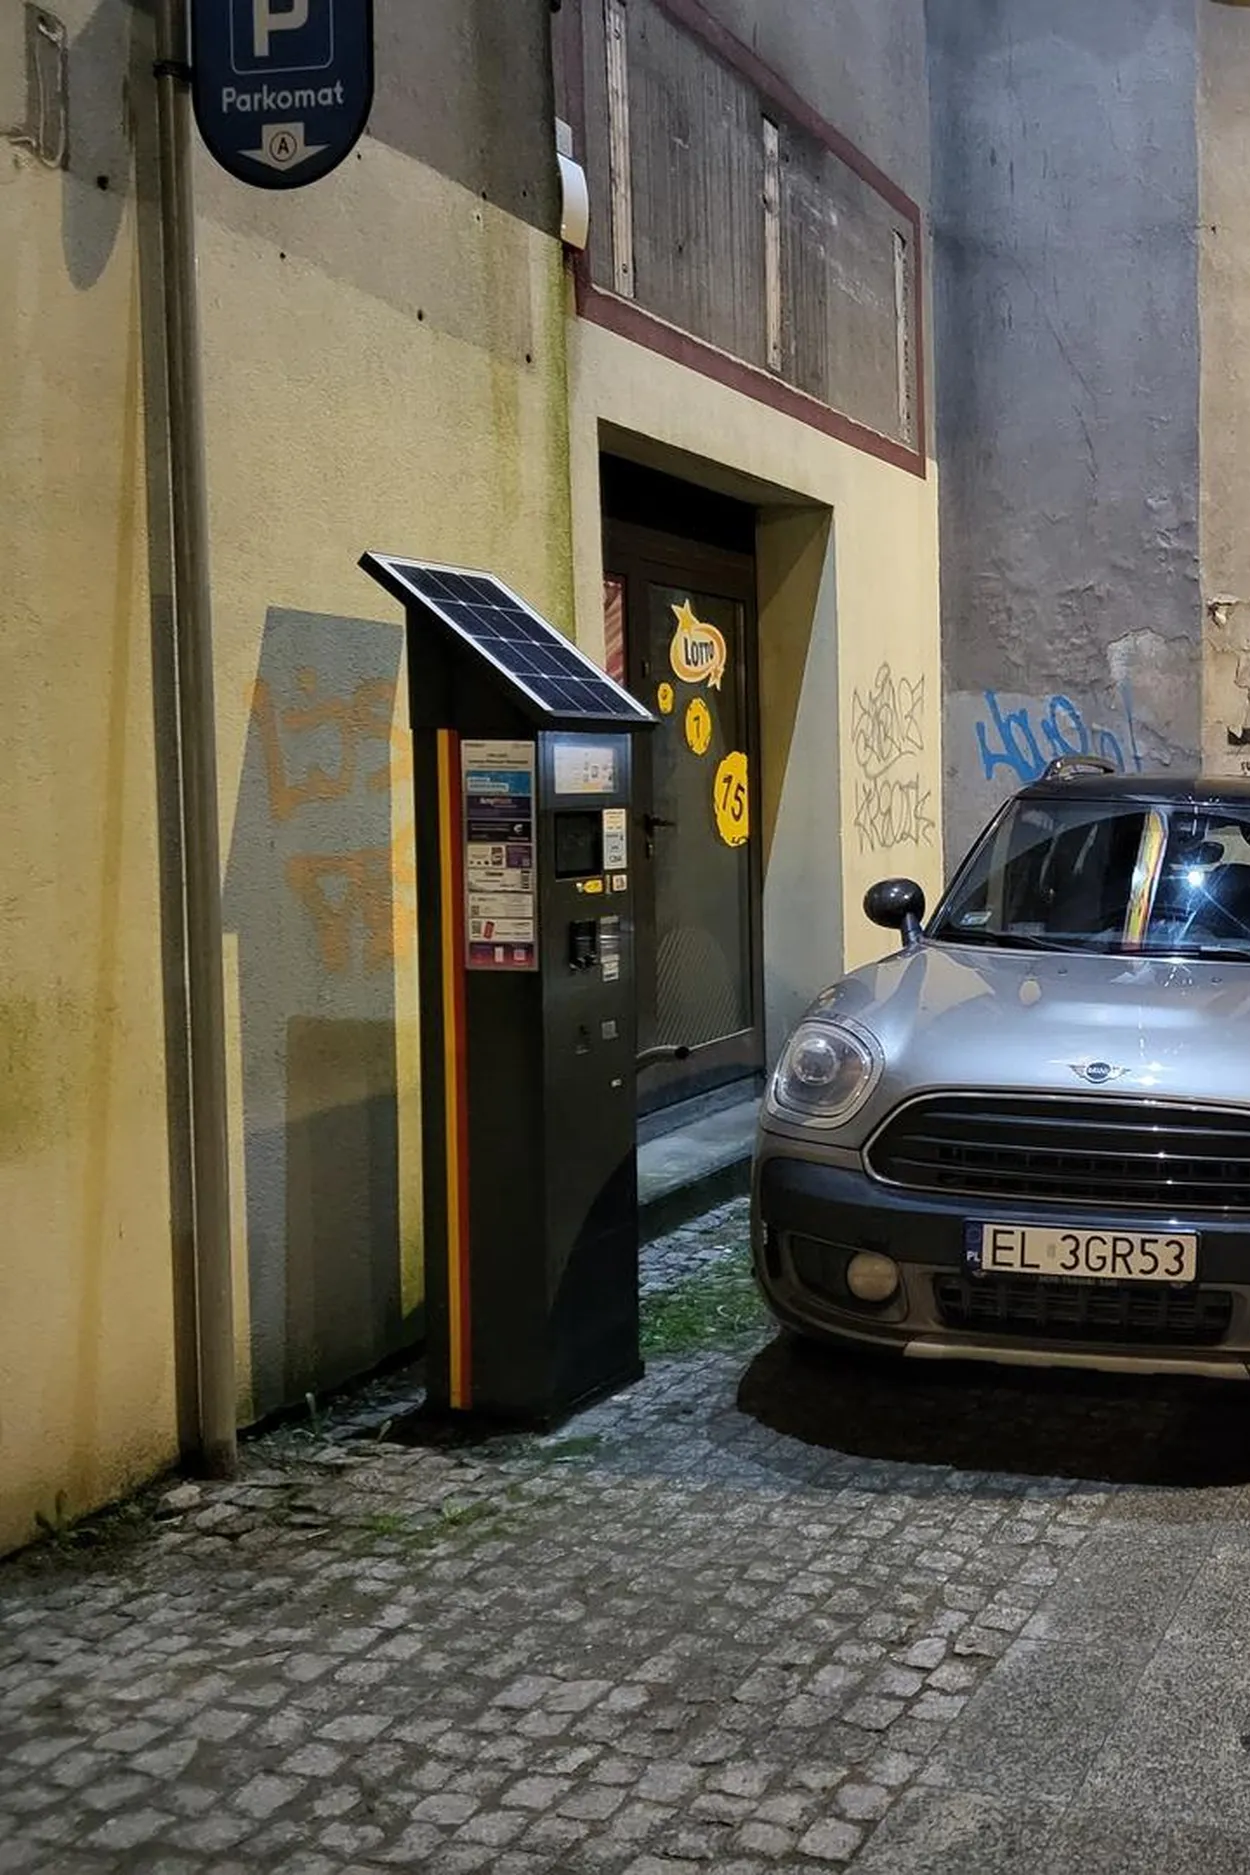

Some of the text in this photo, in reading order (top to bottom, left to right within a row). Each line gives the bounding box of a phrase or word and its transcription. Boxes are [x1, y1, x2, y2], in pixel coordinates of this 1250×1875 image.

[253, 0, 308, 57] P
[221, 80, 344, 114] Parkomat
[277, 137, 290, 155] A
[966, 1251, 981, 1262] PL
[991, 1229, 1186, 1276] EL 3GR53
